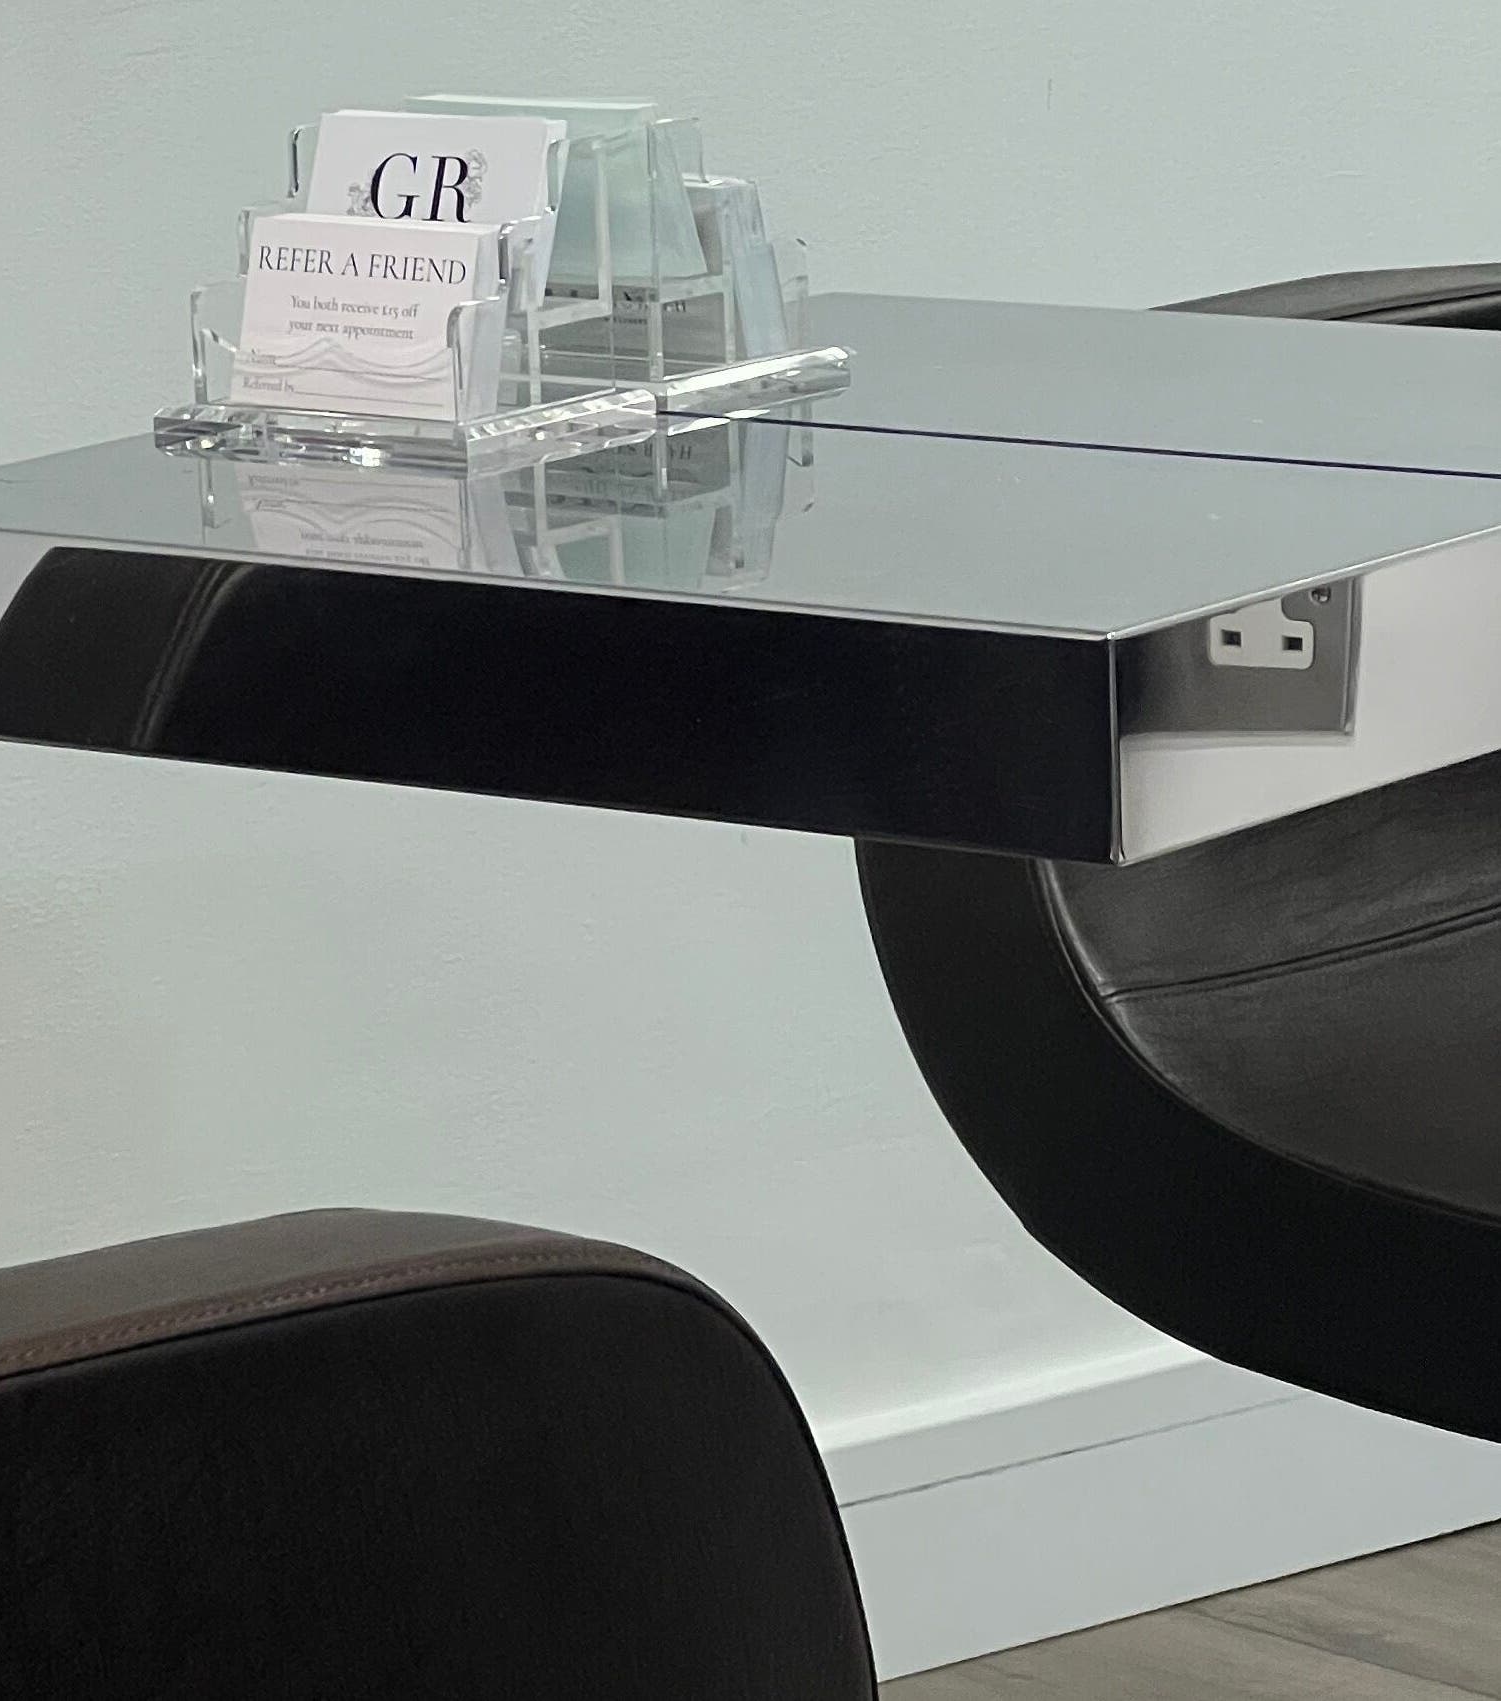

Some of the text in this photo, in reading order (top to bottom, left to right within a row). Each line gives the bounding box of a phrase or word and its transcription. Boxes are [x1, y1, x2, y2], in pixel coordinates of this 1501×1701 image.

[370, 152, 471, 223] GR
[258, 245, 467, 285] REFER A FRIEND
[290, 295, 311, 310] You
[313, 296, 339, 312] both
[341, 303, 378, 315] receive
[401, 303, 421, 318] off
[288, 320, 414, 340] your next appointment
